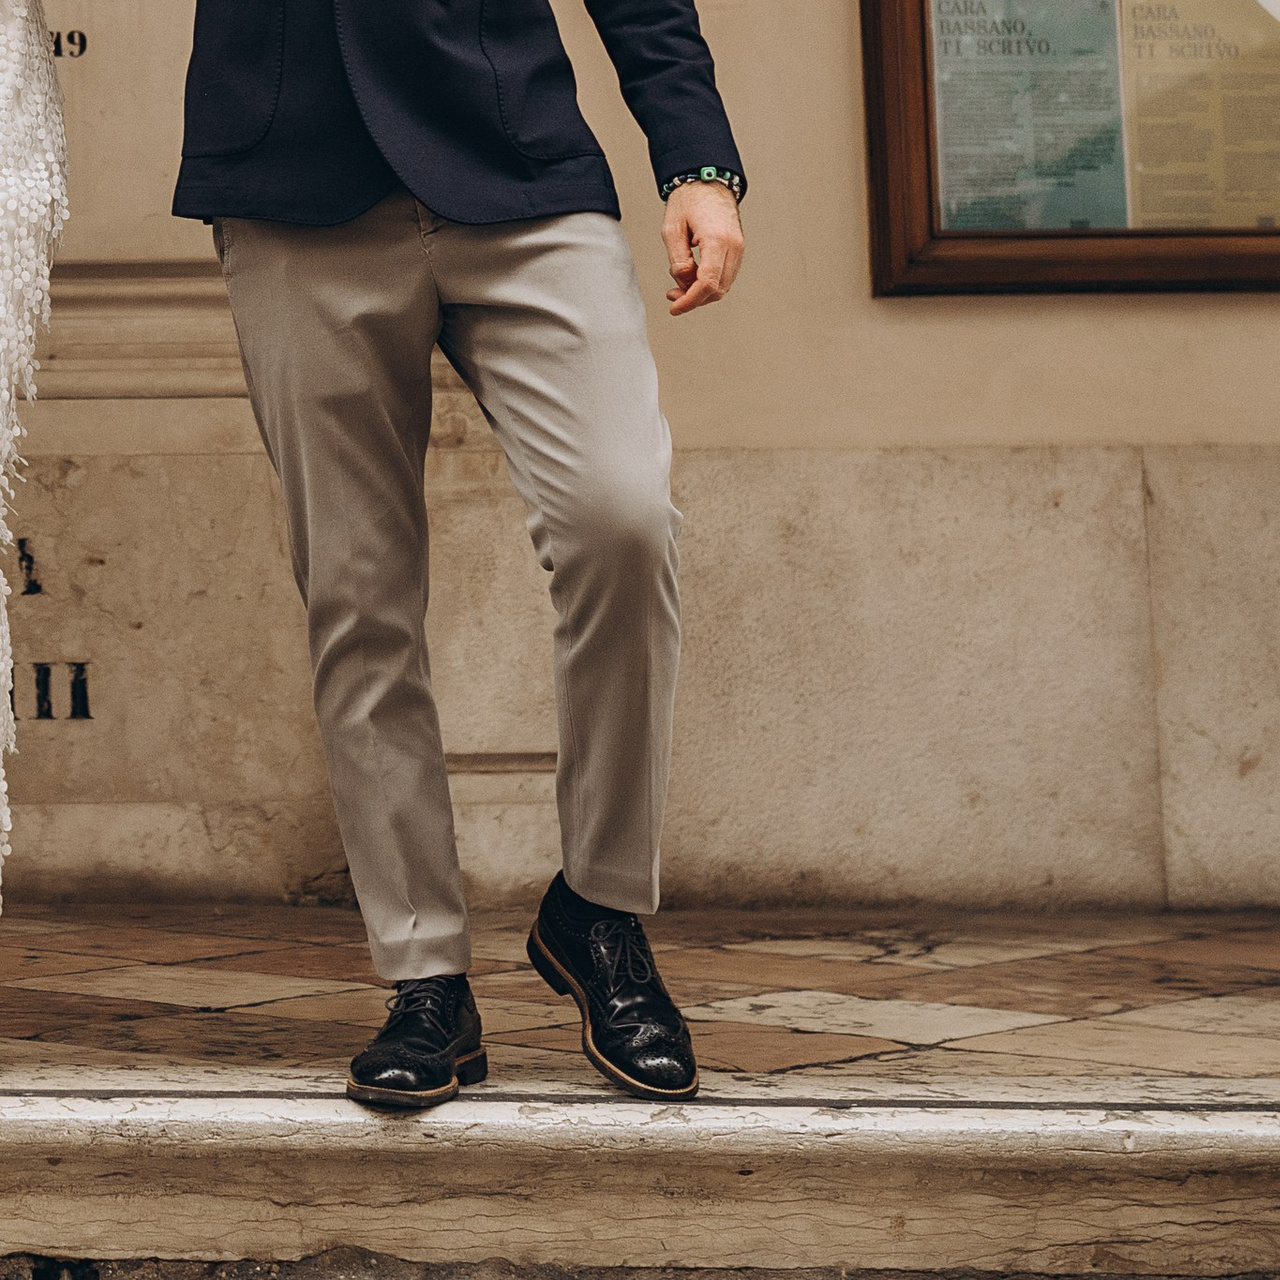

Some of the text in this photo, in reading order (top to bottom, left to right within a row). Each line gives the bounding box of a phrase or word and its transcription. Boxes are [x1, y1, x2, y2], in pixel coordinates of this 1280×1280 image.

[937, 0, 987, 15] CARA
[1131, 4, 1180, 21] CARA
[939, 39, 962, 56] TI
